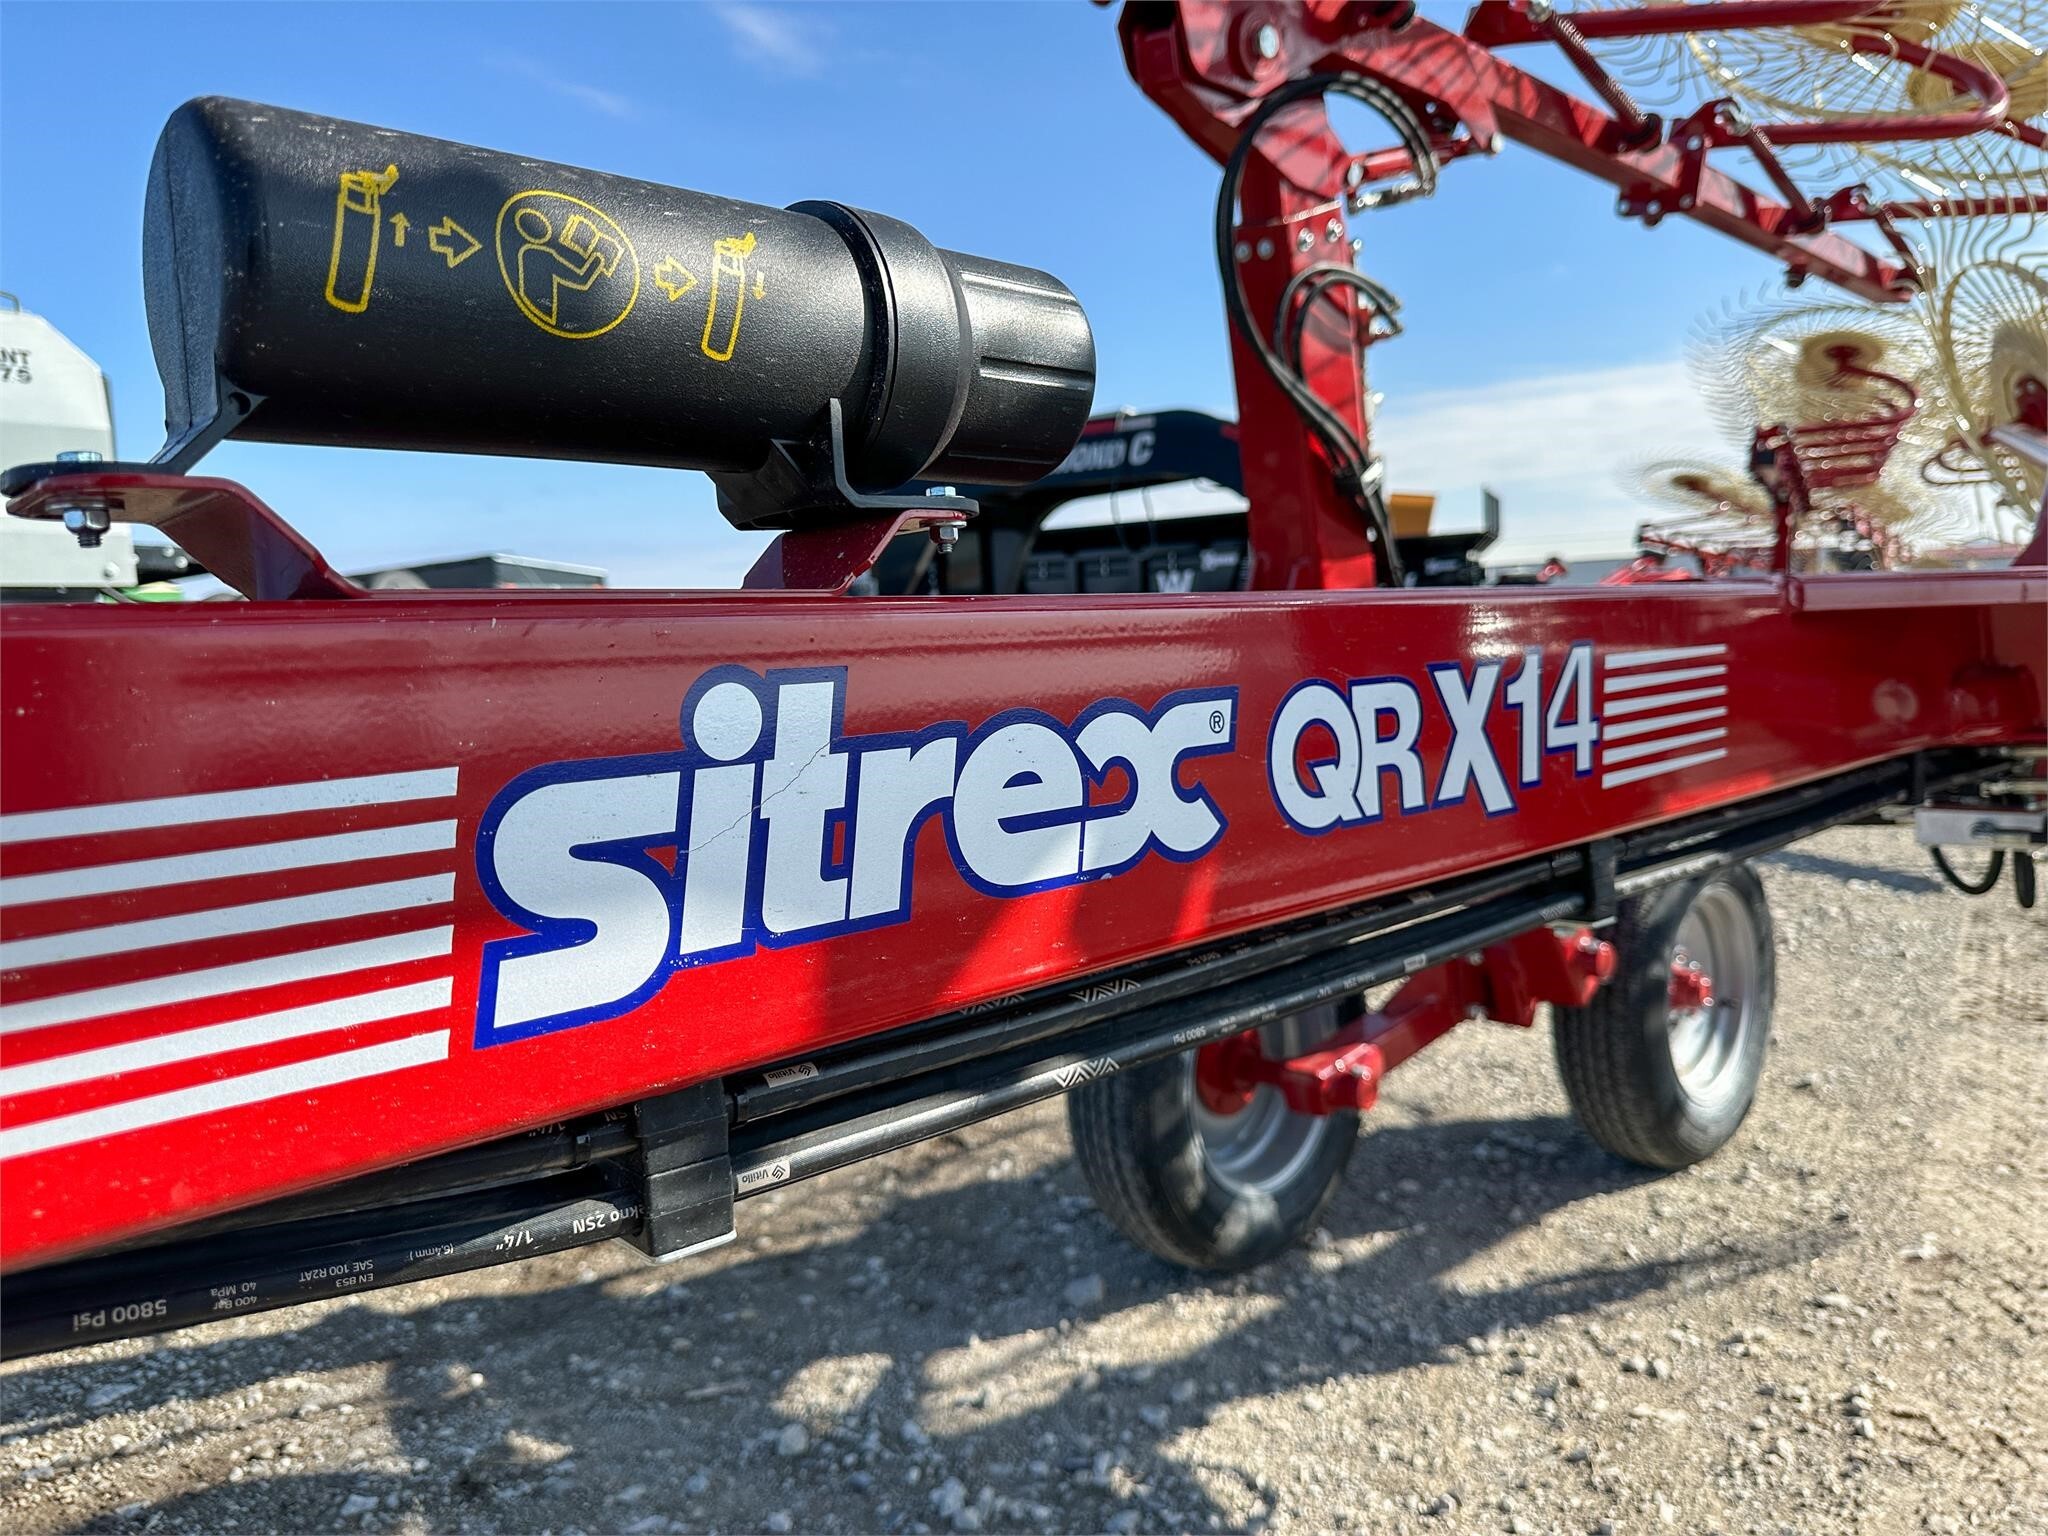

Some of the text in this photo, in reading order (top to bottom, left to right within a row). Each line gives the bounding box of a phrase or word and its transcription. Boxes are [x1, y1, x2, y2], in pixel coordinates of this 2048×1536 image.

[742, 1169, 769, 1183] Vitillo
[573, 1213, 606, 1234] 2SN
[495, 1229, 534, 1250] 1/4"
[299, 1258, 374, 1282] SAE 100 R2AT
[210, 1280, 258, 1298] 40 MPa
[335, 1272, 375, 1288] EN 853
[235, 1295, 258, 1309] 400
[72, 1298, 168, 1332] 5800 Psi
